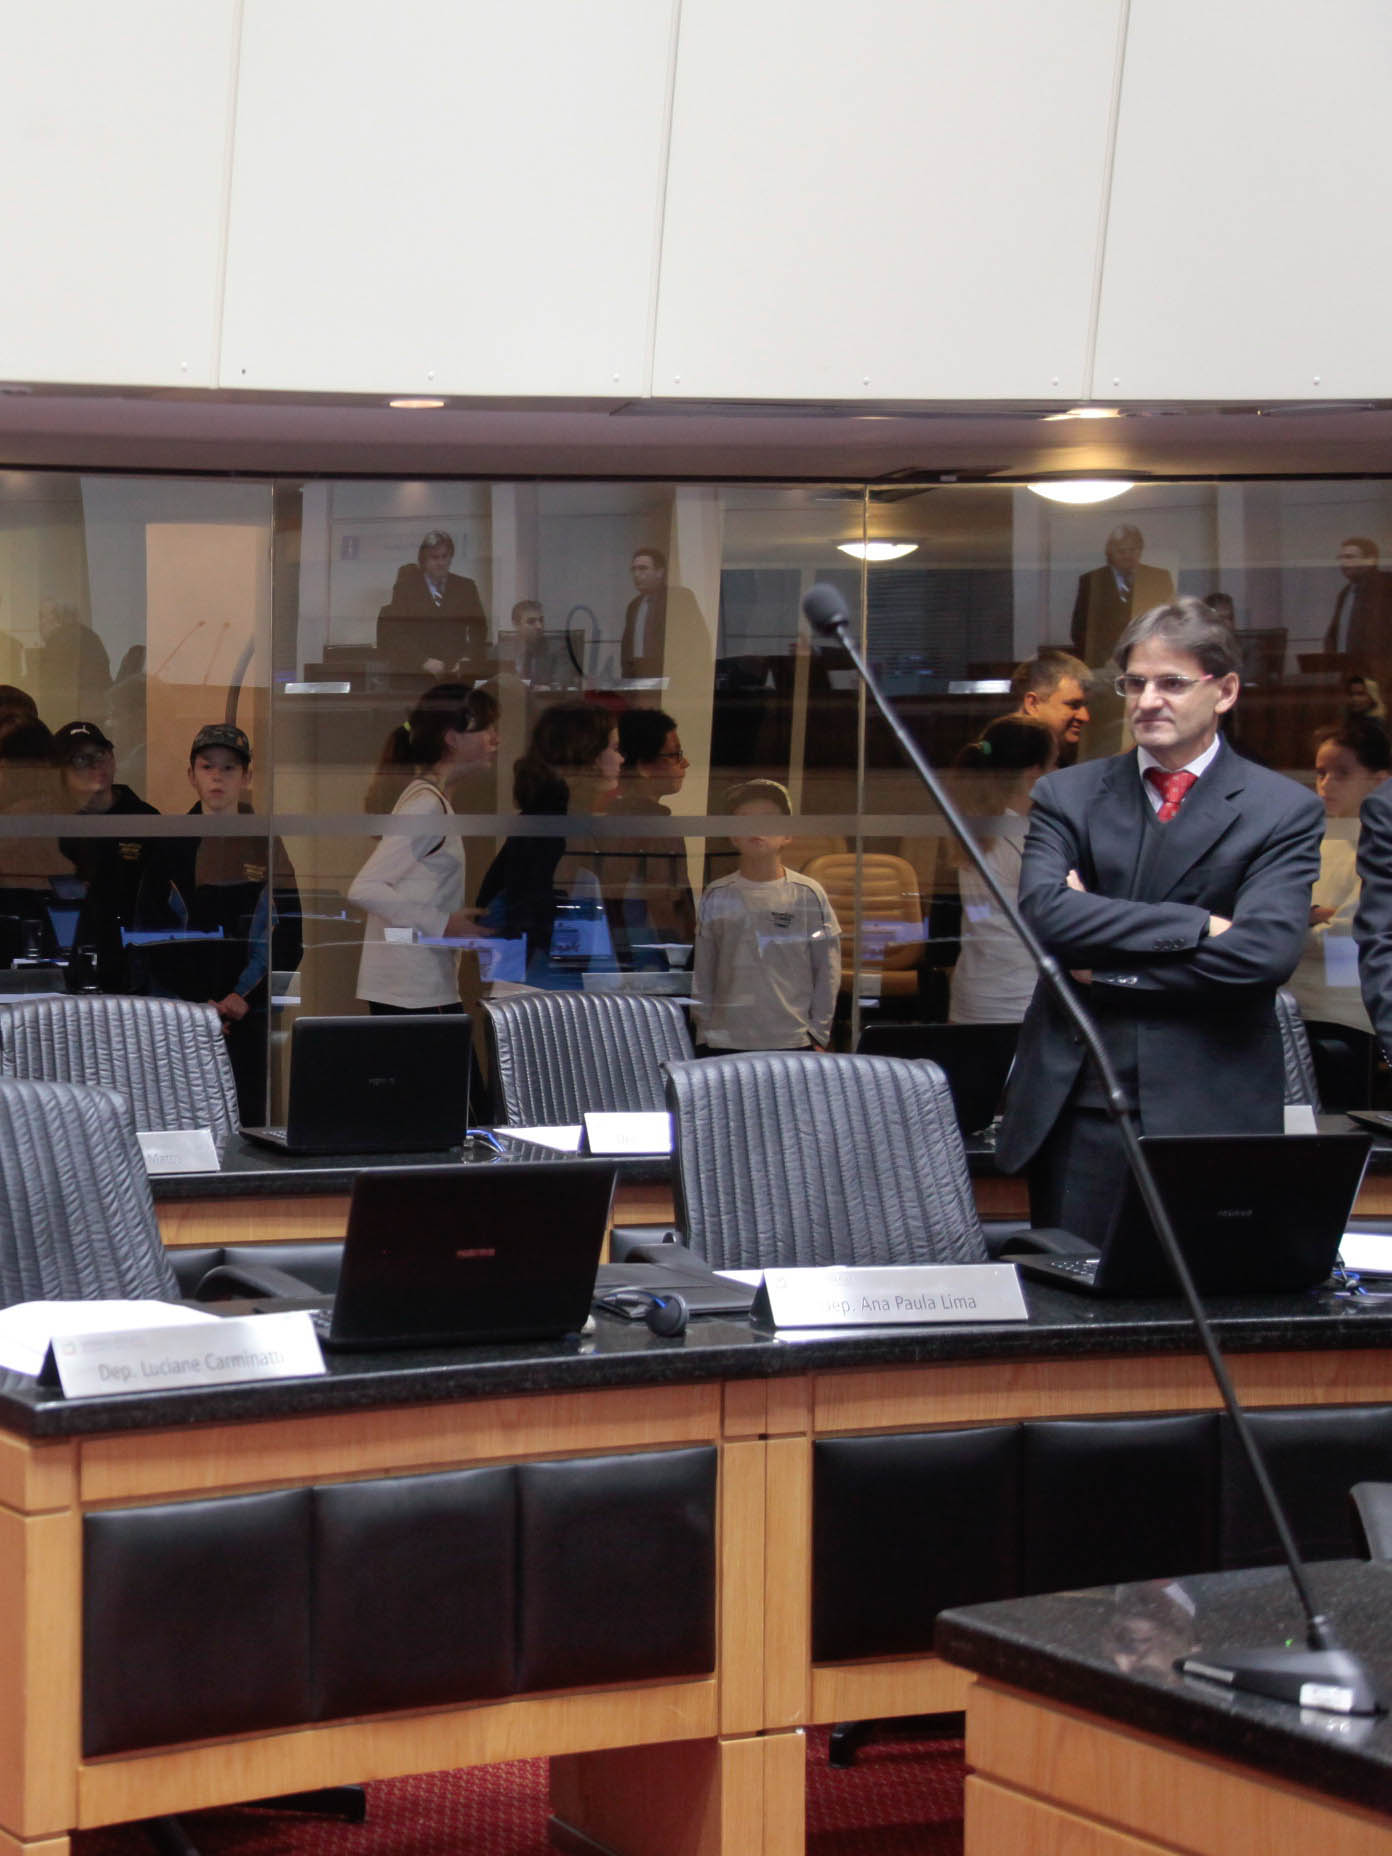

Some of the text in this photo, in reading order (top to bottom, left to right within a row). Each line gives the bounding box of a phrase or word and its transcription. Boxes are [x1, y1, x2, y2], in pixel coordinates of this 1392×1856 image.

[861, 1296, 891, 1312] Ana
[895, 1294, 936, 1311] Paula
[942, 1294, 977, 1310] Lima
[97, 1361, 134, 1382] Dep.
[140, 1355, 201, 1377] Luciane
